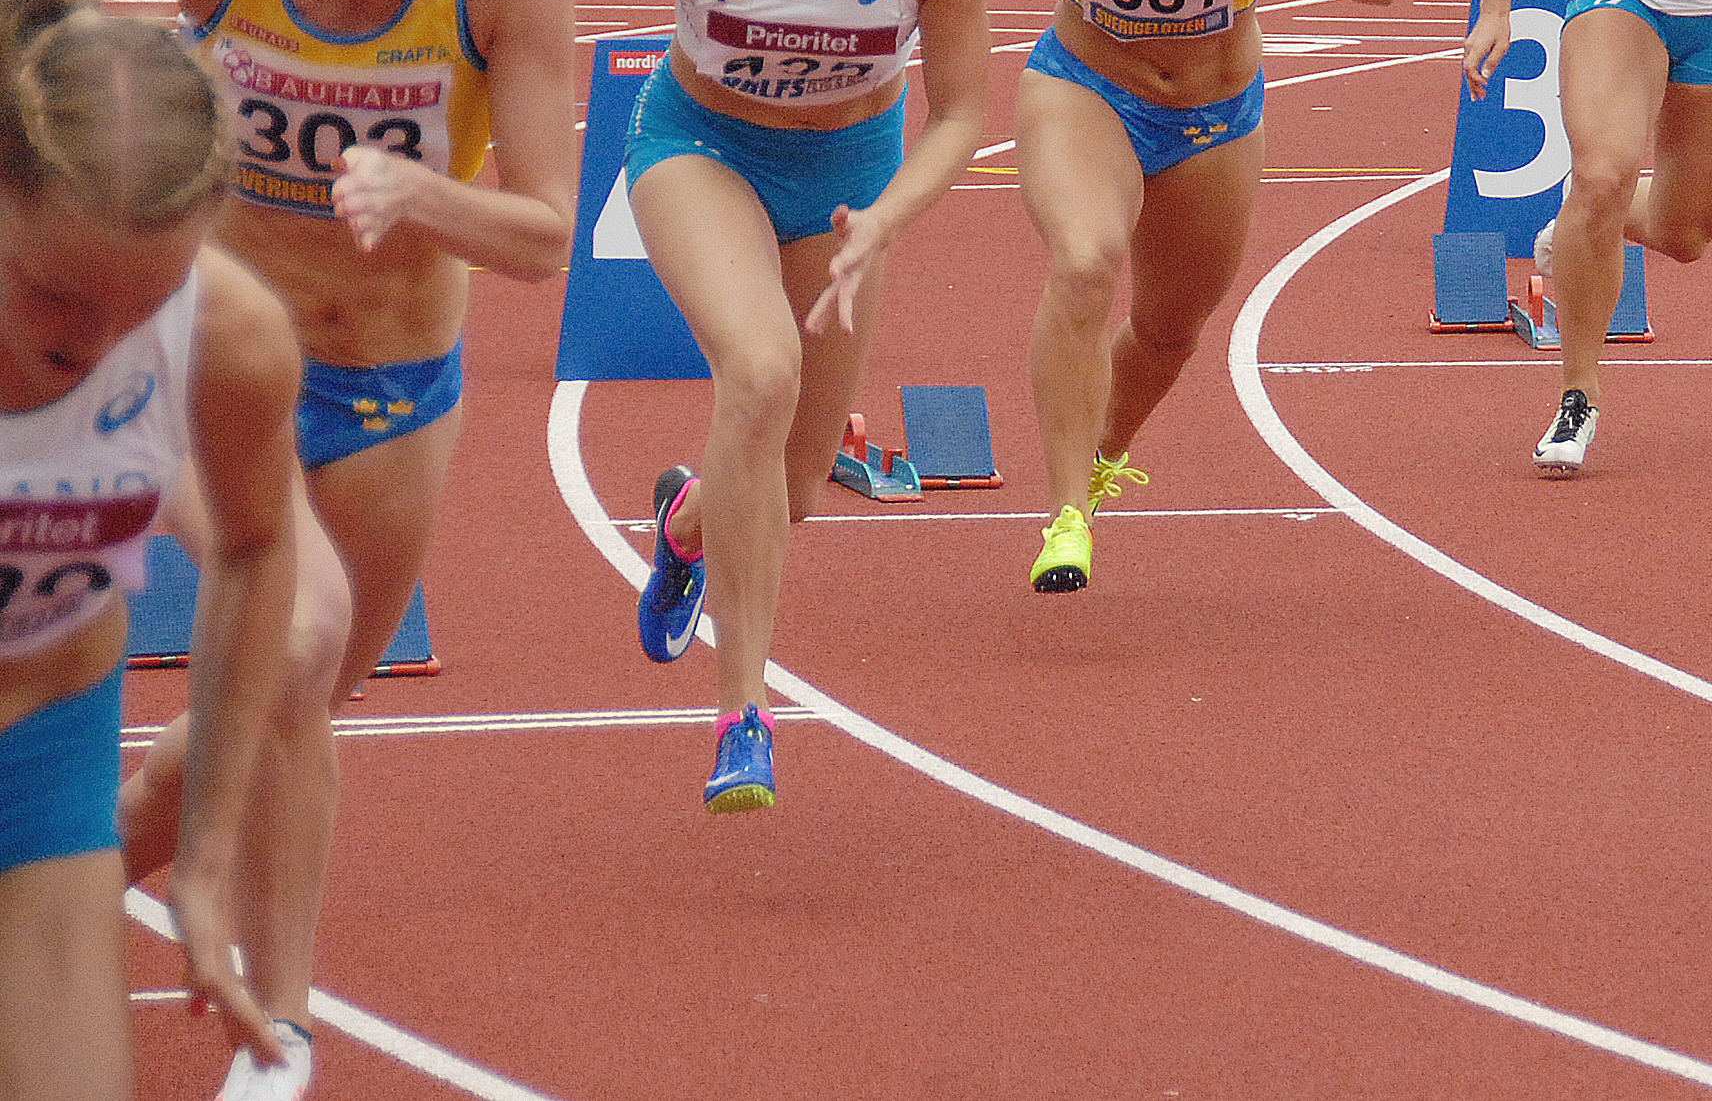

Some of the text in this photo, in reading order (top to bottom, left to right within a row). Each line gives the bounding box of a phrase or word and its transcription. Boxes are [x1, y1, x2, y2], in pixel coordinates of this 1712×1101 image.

[745, 25, 859, 53] Prioritet
[254, 67, 440, 108] BAUHAUS
[1473, 8, 1572, 198] 3
